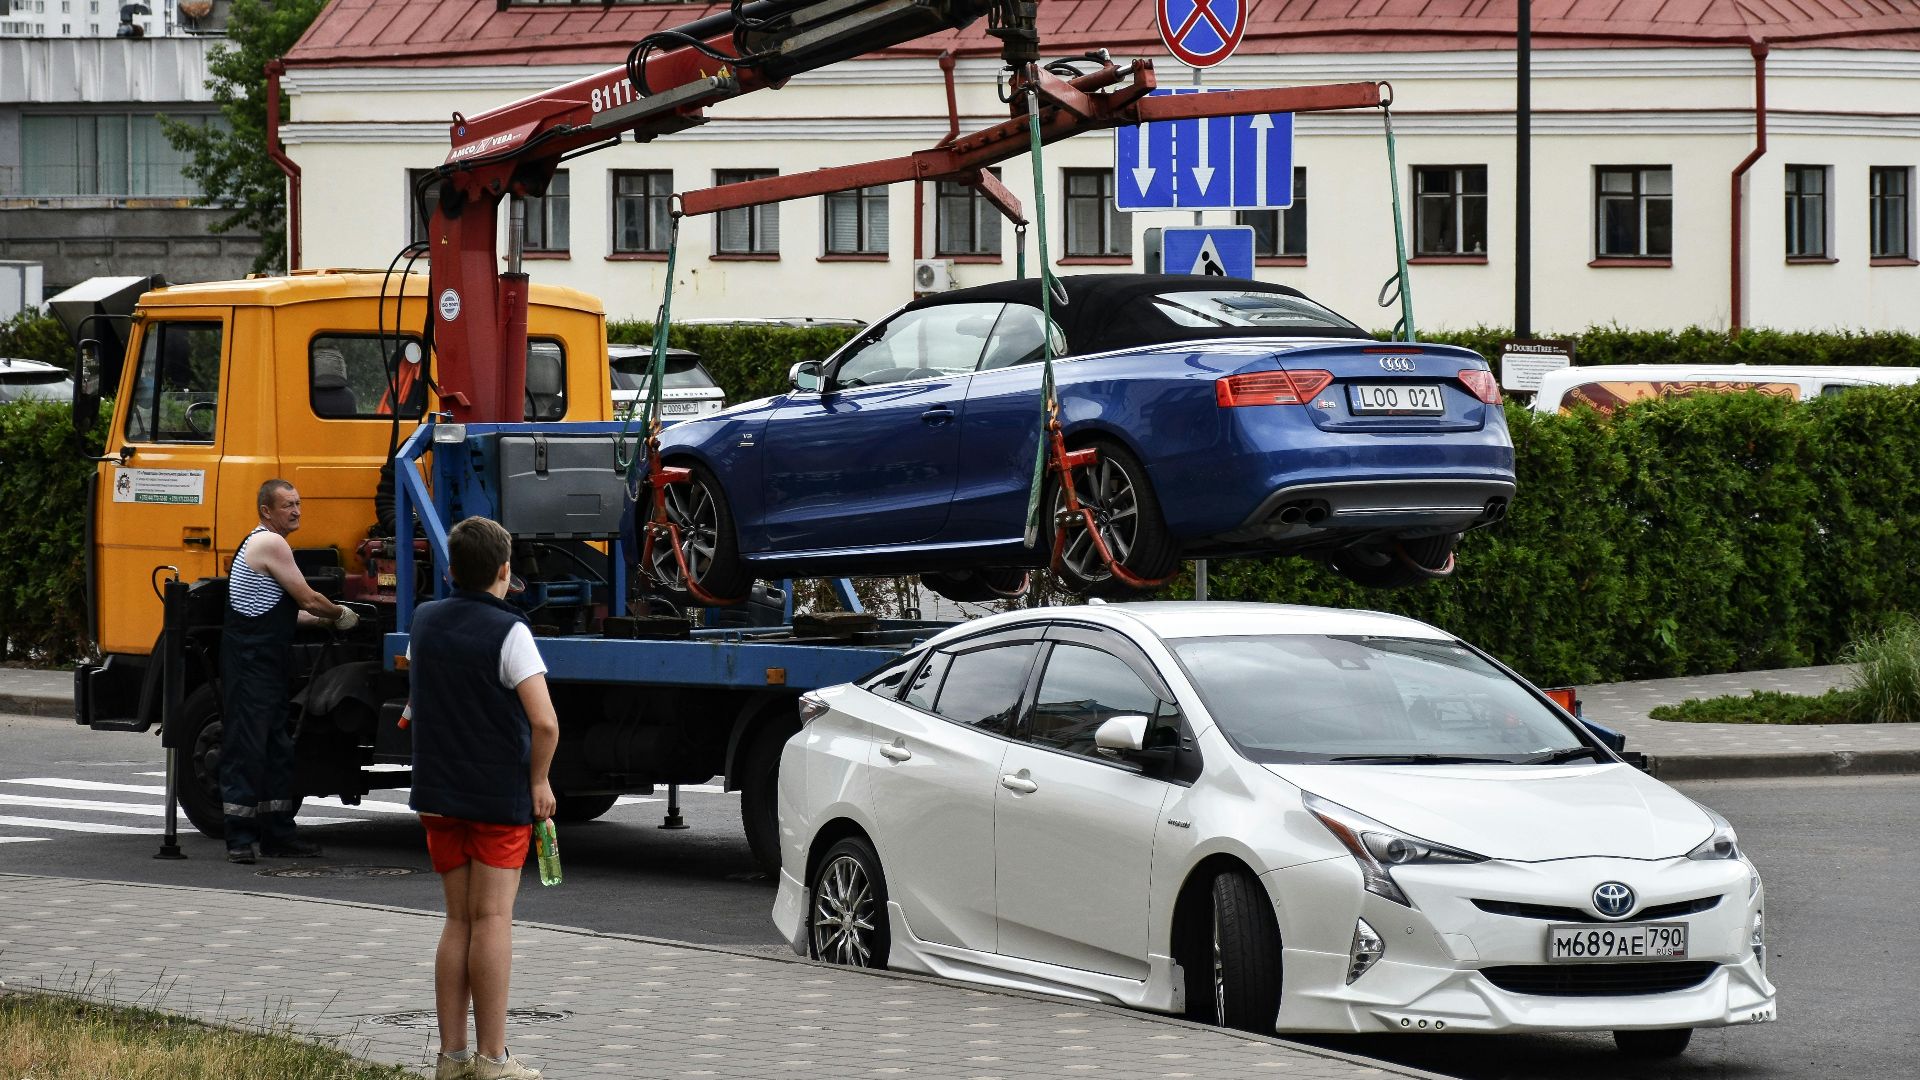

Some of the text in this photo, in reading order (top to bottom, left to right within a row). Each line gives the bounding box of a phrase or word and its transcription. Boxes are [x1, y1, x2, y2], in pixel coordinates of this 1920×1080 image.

[591, 78, 631, 112] 811T
[450, 145, 476, 160] AMCO
[492, 133, 513, 146] VEBA
[1361, 387, 1439, 408] LOO 021
[1648, 928, 1682, 948] 790
